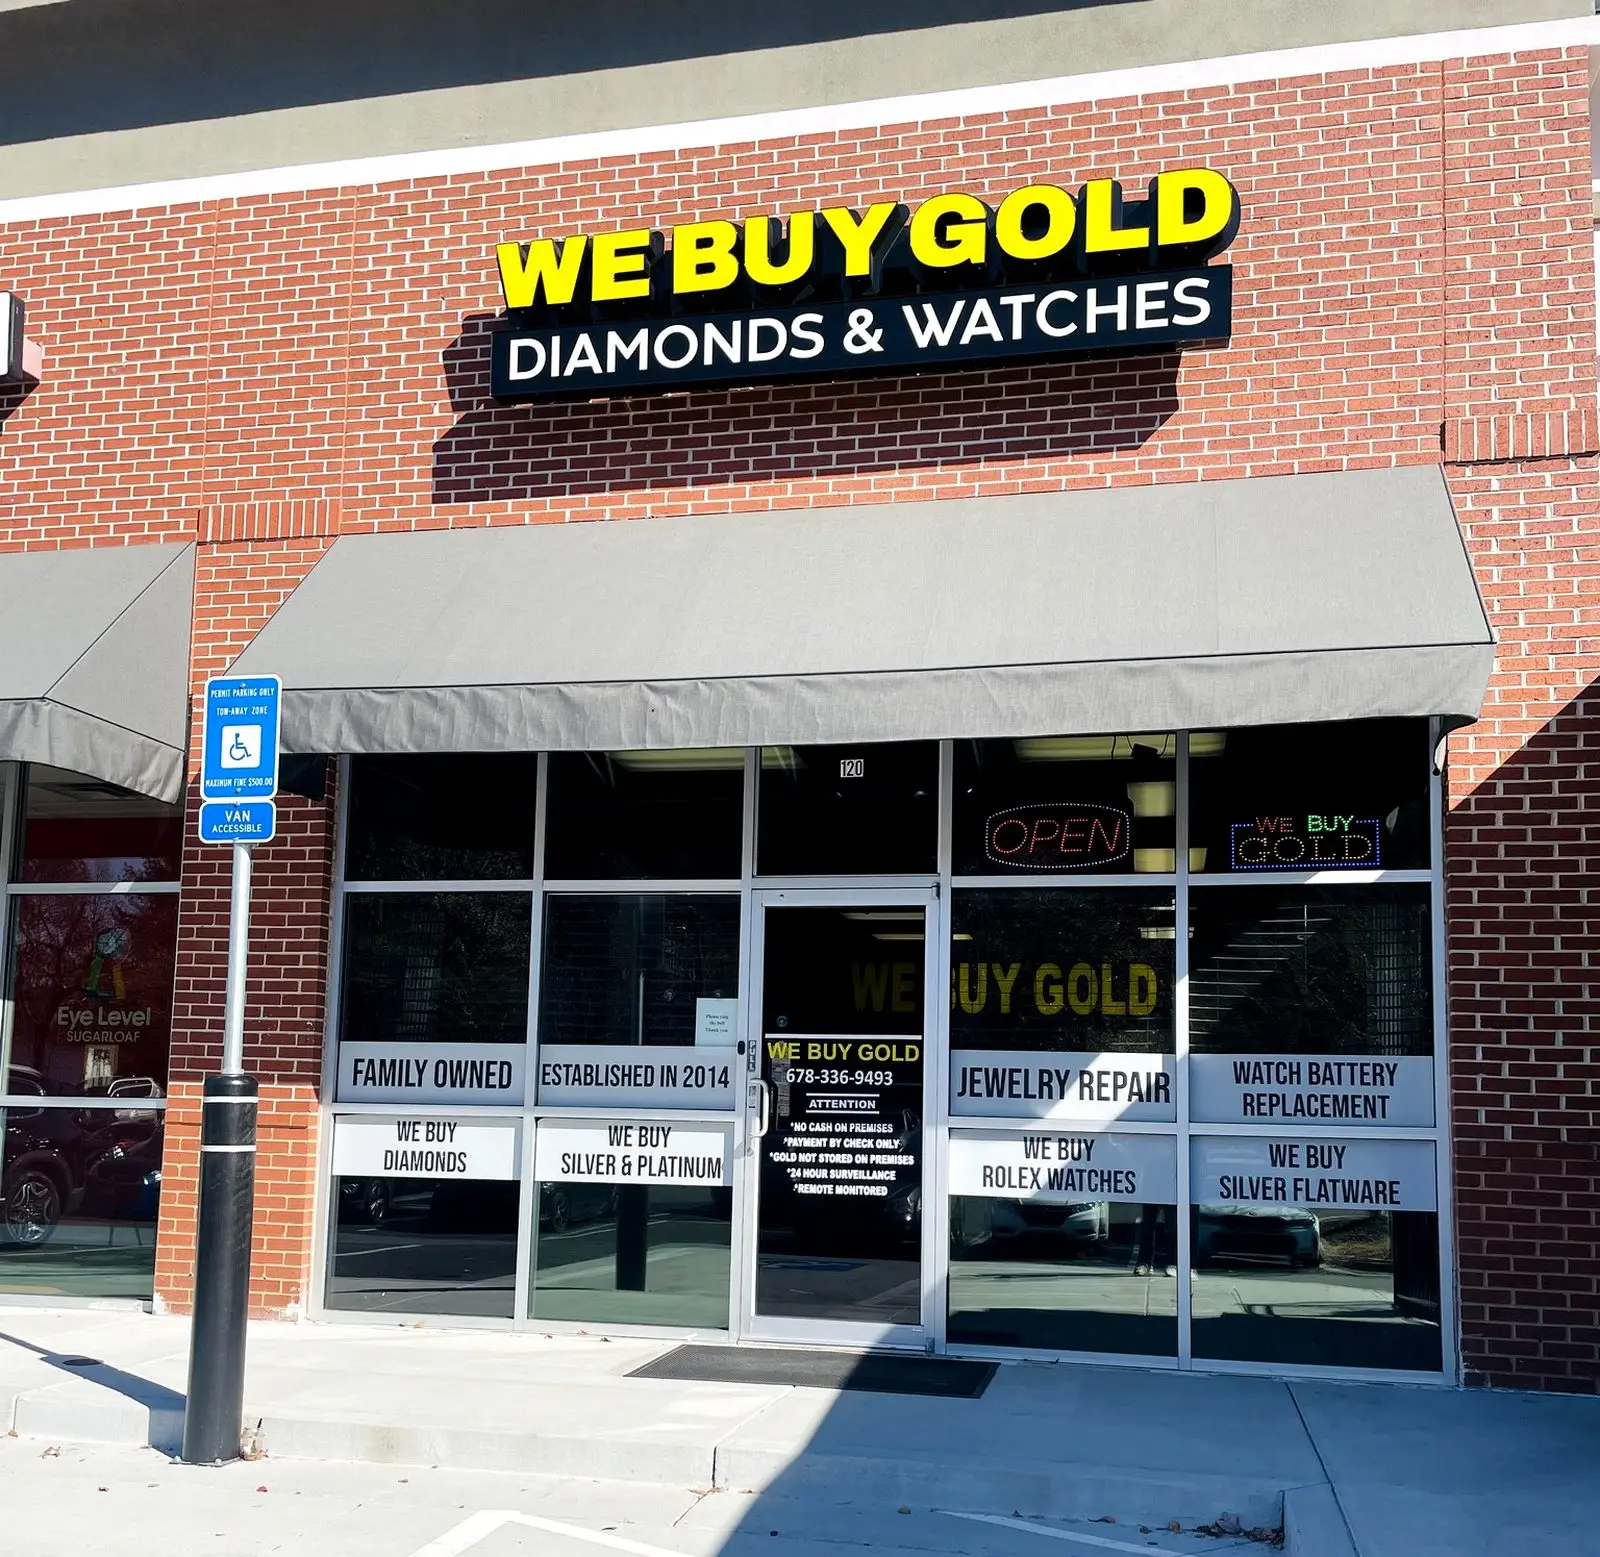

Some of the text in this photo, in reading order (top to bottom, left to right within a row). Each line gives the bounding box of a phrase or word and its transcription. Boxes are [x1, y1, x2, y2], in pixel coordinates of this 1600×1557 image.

[496, 167, 1232, 309] WE BUY GOLD
[508, 277, 1211, 382] DIAMONDS & WATCHES
[210, 687, 275, 698] PERMIT PARKING ONLY
[216, 705, 268, 717] TOW-AWAY ZONE
[841, 760, 863, 777] 120
[205, 777, 273, 787] MAXIMUM FINE $500.00
[211, 823, 262, 833] ACCESSIBLE
[225, 810, 250, 822] VAN
[1255, 814, 1355, 833] WE BUY
[991, 817, 1121, 854] OPEN
[1238, 834, 1373, 862] GOLD
[852, 962, 1158, 1016] WE UY GOLD
[57, 1006, 151, 1030] Eye Level
[67, 1030, 141, 1043] SUGARLOAF
[768, 1042, 920, 1062] WE BUY GOLD
[352, 1057, 513, 1090] FAMILY OWNED
[541, 1063, 730, 1089] ESTABLISHED IN 2014
[786, 1068, 894, 1086] 678-336-9493
[956, 1066, 1171, 1104] JEWELRY REPAIR
[1233, 1060, 1399, 1087] WATCH BATTERY
[808, 1099, 876, 1109] ATTENTION
[1242, 1092, 1390, 1119] REPLACEMENT
[397, 1120, 458, 1144] WE BUY
[607, 1125, 672, 1149] WE BUY
[808, 1122, 833, 1132] CASH
[834, 1122, 848, 1133] ON
[849, 1123, 894, 1134] PREMISES
[830, 1137, 841, 1148] BY
[843, 1138, 875, 1149] CHECK
[876, 1138, 900, 1149] ONLY
[1023, 1136, 1096, 1161] WE BUY
[383, 1149, 467, 1174] DIAMONDS
[560, 1152, 723, 1180] SILVER & PLATINUM
[798, 1152, 818, 1163] NOT
[818, 1153, 853, 1164] STORED
[854, 1154, 868, 1164] ON
[869, 1154, 915, 1165] PREMISES
[1268, 1143, 1347, 1170] WE BUY
[803, 1168, 829, 1179] HOUR
[829, 1169, 897, 1181] SURVEILLANCE
[982, 1164, 1137, 1195] ROLEX WATCHES
[835, 1184, 888, 1196] MONITORED
[1219, 1175, 1401, 1205] SILVER FLATWARE
